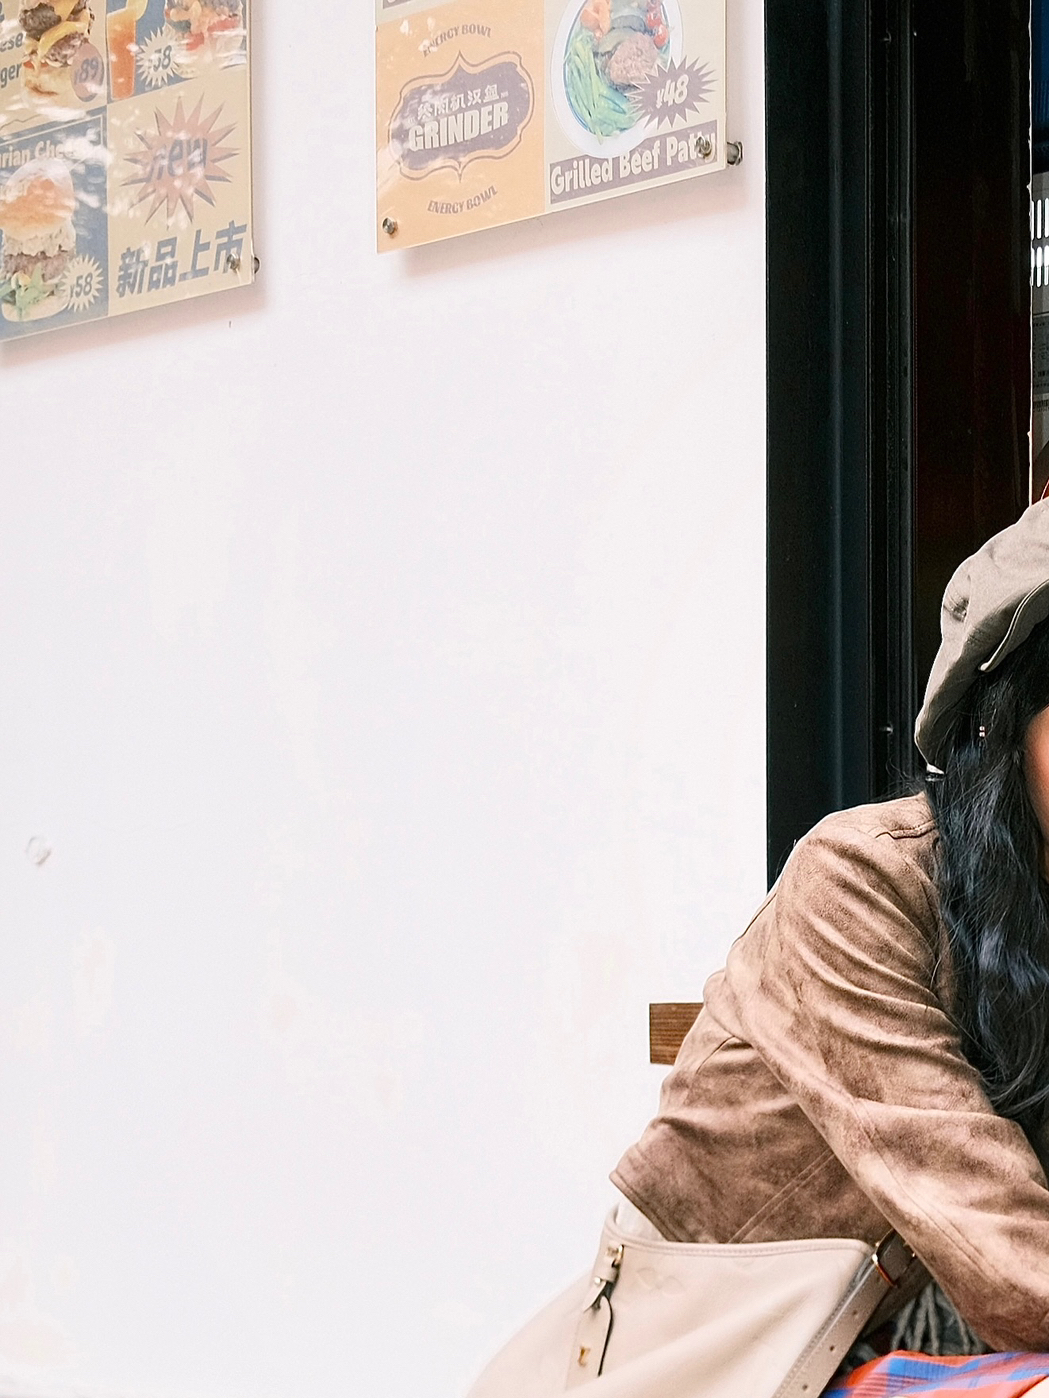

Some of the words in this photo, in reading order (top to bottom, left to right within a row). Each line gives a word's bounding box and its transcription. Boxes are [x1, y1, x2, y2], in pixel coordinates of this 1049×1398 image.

[461, 23, 493, 39] BOWL
[408, 101, 509, 152] GRINDER
[550, 157, 613, 196] Grilled
[619, 139, 661, 179] Beef
[427, 199, 464, 215] ENERGY
[466, 185, 498, 211] BOWL
[115, 219, 249, 298] 新品上市
